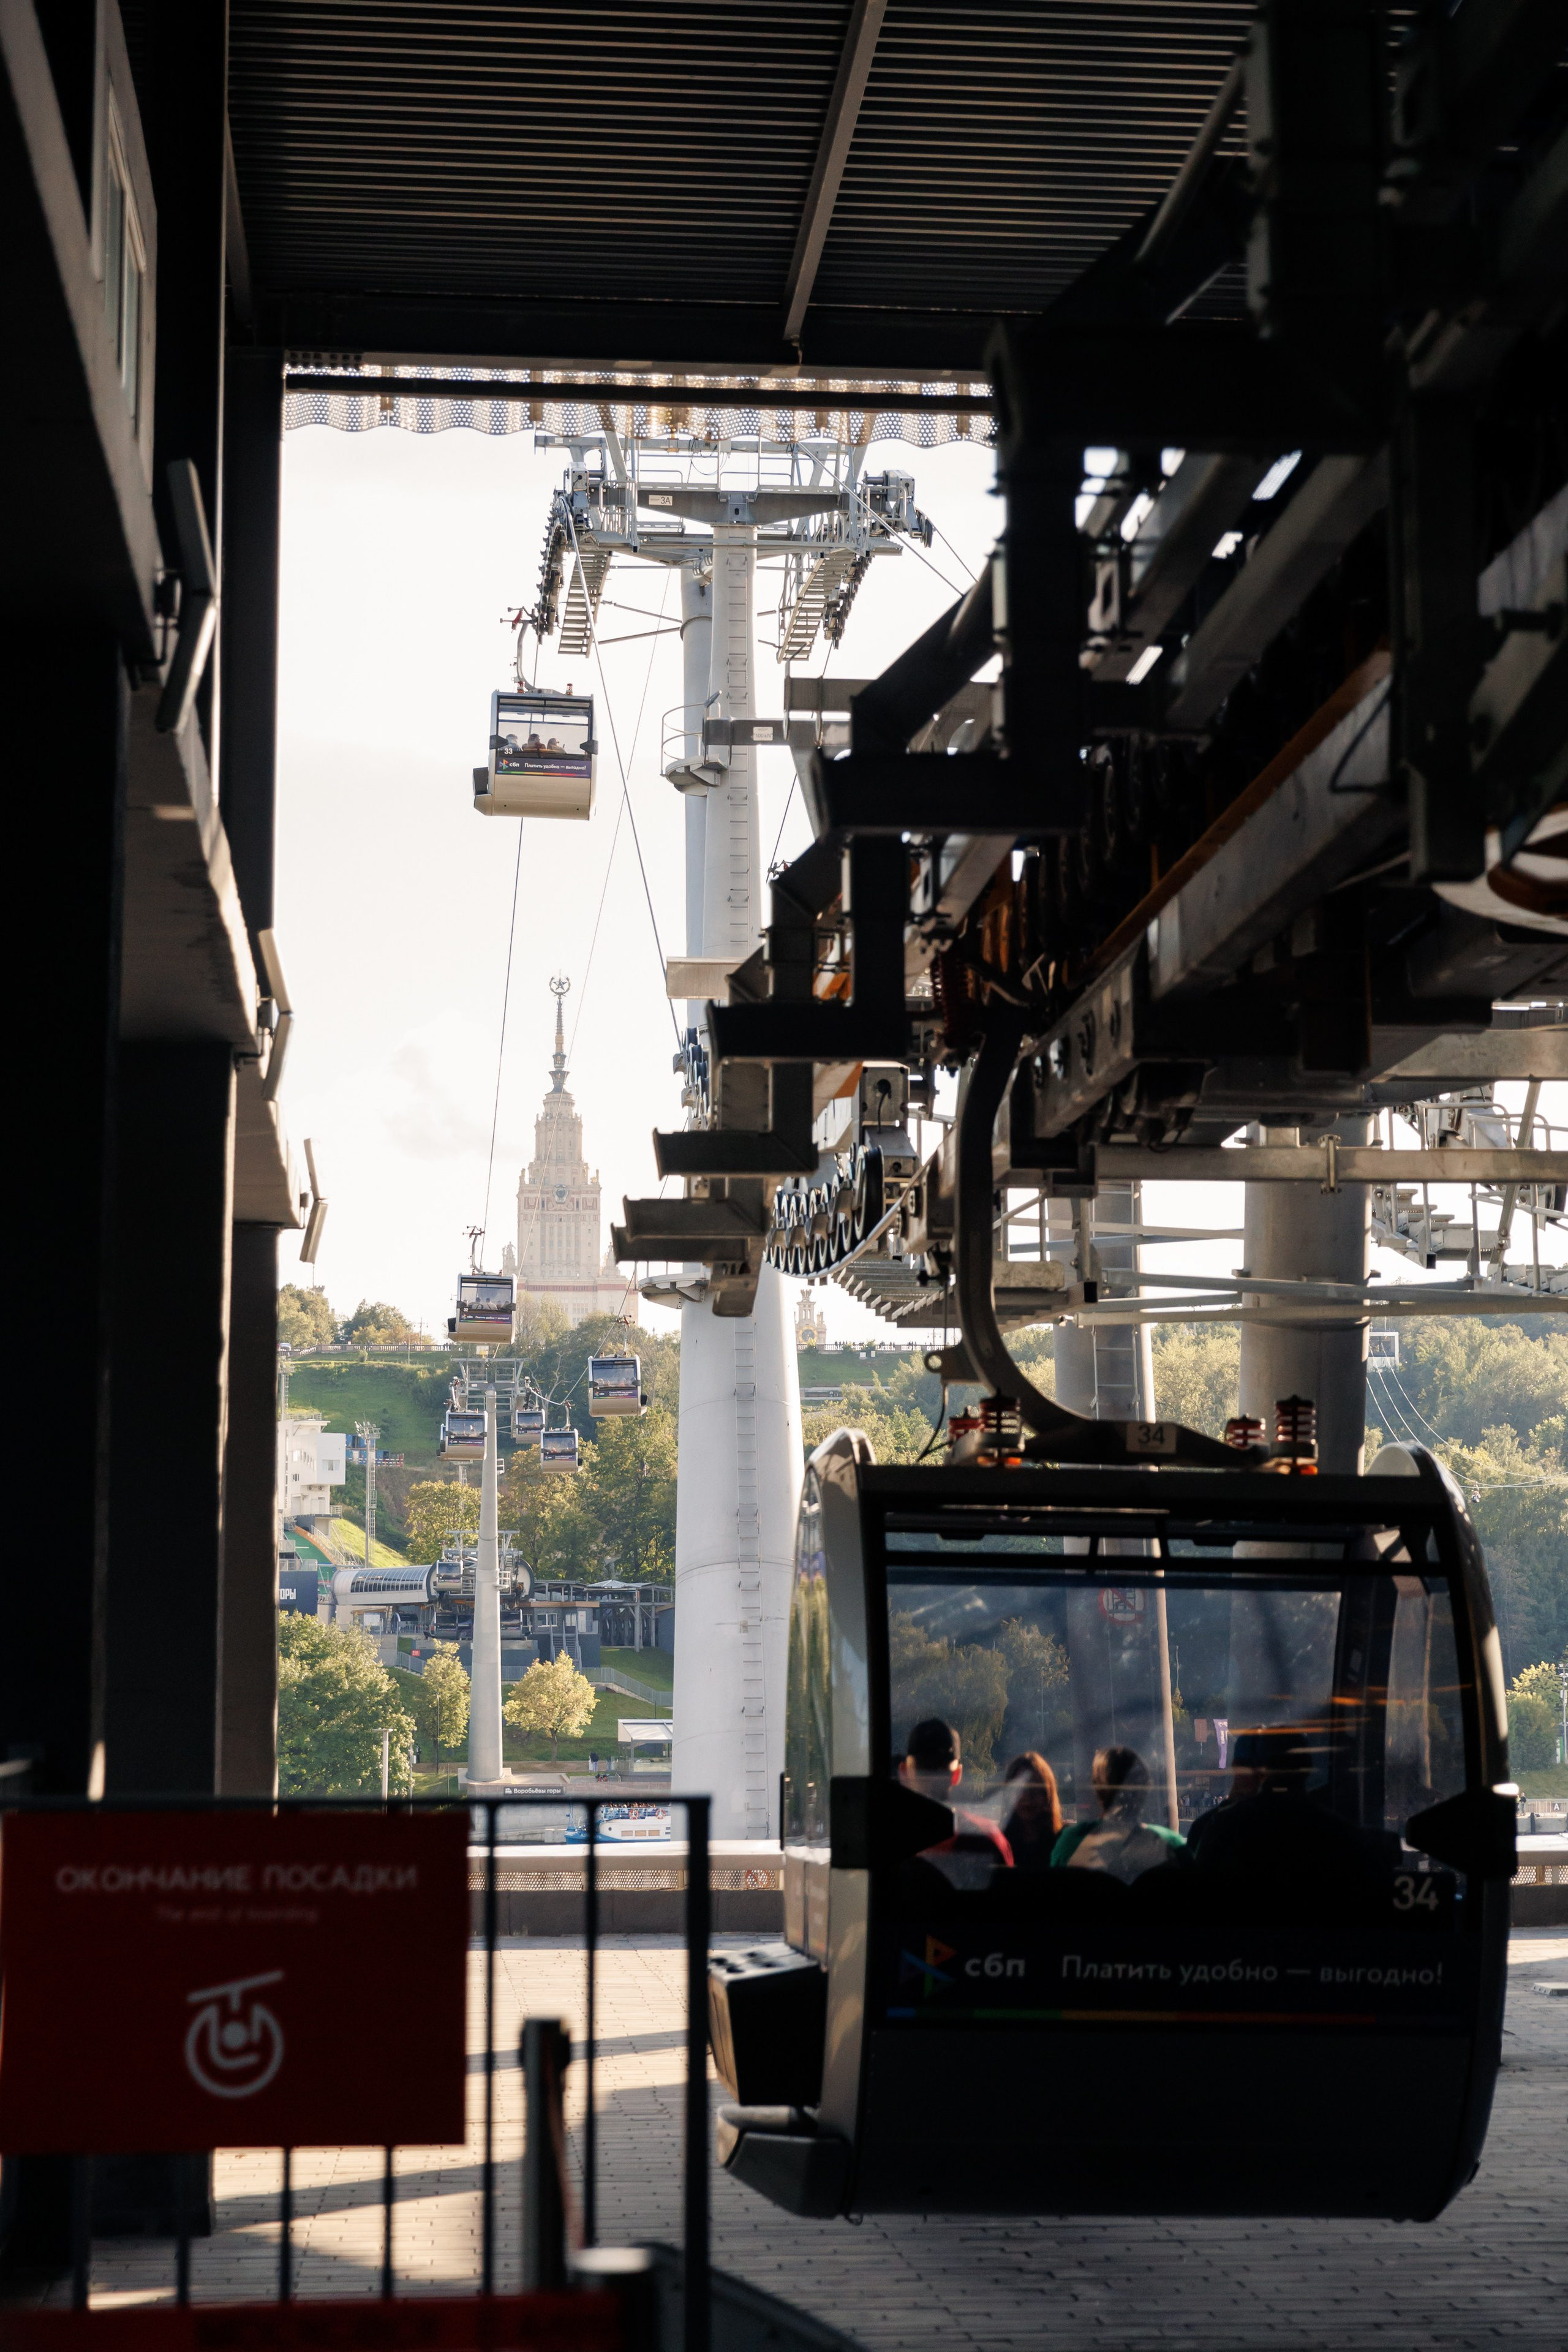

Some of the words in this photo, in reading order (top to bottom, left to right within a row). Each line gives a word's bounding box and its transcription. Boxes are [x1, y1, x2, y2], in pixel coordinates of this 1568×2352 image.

[1139, 1424, 1164, 1444] 34
[279, 1588, 296, 1599] ОРЫ
[55, 1864, 251, 1892] ОКОНЧАНИЕ
[263, 1864, 417, 1893] ПОСАДКИ
[1392, 1875, 1439, 1912] 34
[963, 1952, 1026, 1978] сбп
[1061, 1954, 1172, 1979] Платить
[1178, 1958, 1278, 1986] удобно
[1319, 1962, 1443, 1986] выгодно!
